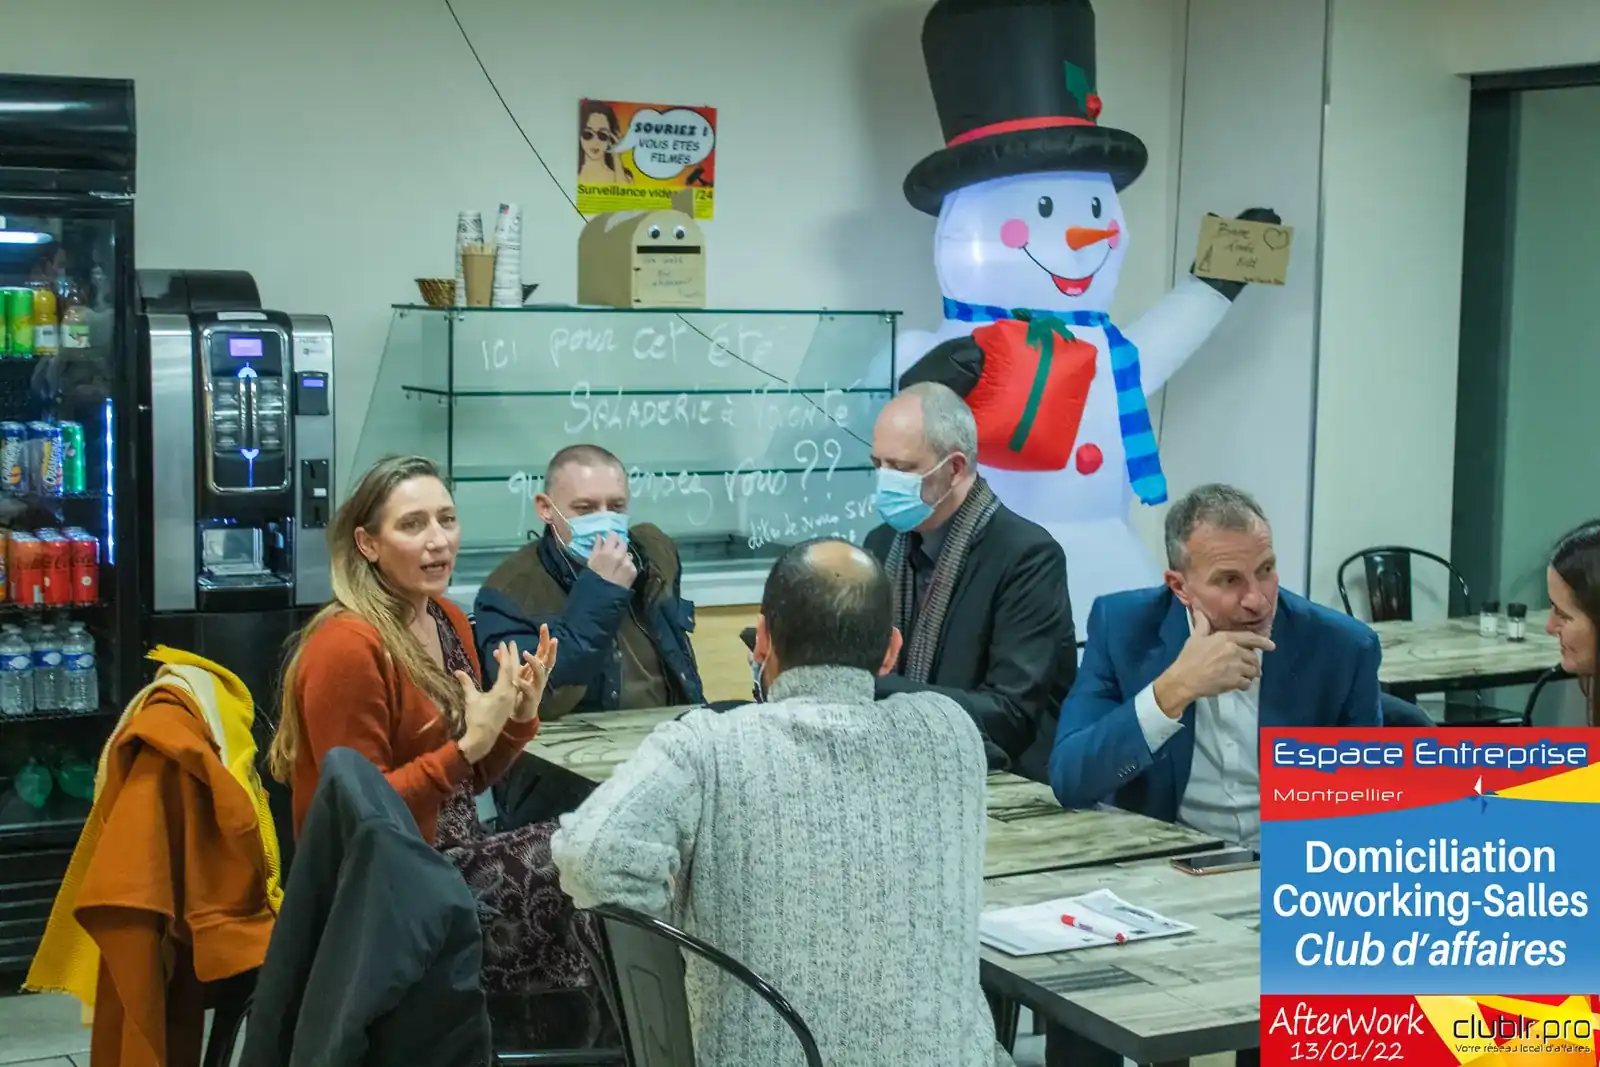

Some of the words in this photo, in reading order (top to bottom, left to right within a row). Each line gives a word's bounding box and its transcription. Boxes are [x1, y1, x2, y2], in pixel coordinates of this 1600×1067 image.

[634, 122, 696, 136] SOURIEZ
[639, 139, 668, 150] VOUS
[577, 184, 647, 197] Surveillance
[507, 469, 545, 537] qu
[628, 465, 714, 527] ensez
